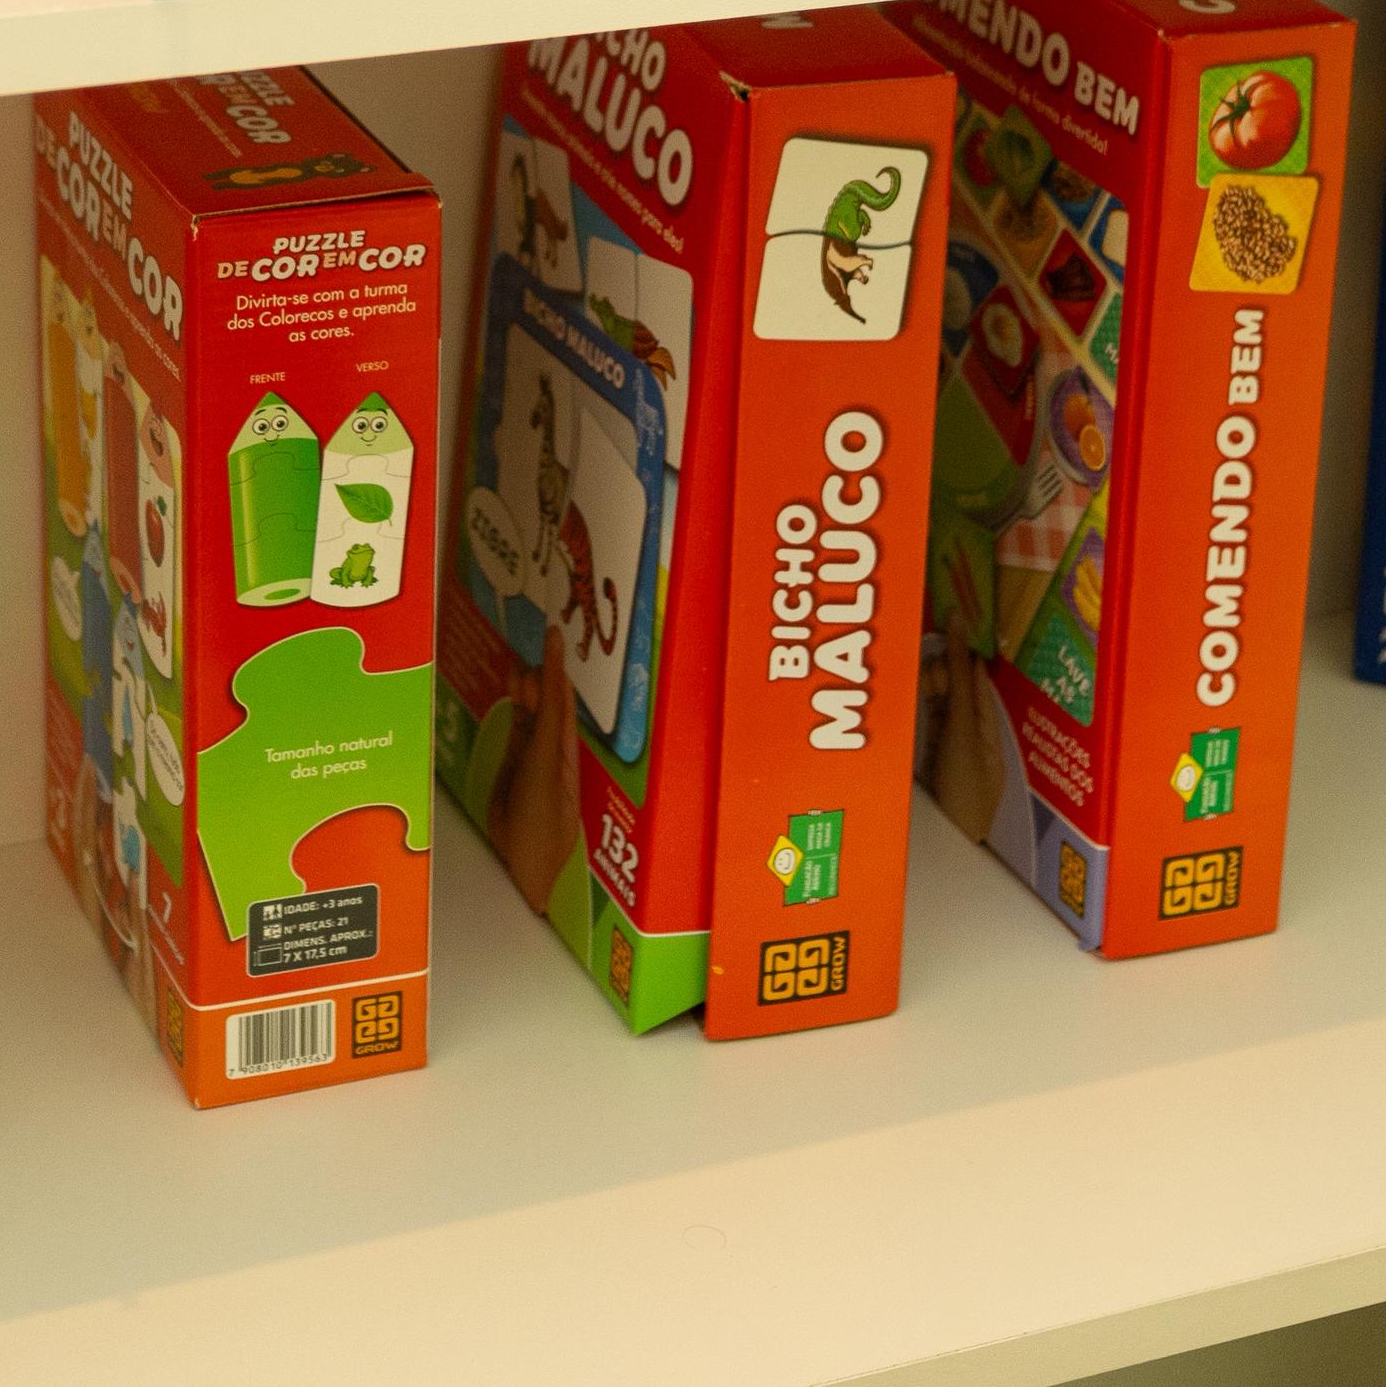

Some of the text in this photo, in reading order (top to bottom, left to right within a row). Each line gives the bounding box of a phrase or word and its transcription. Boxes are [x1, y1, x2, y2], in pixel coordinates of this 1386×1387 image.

[1073, 60, 1140, 136] BEM
[527, 37, 693, 206] MALUCO
[68, 111, 133, 221] PUZZLE
[56, 145, 100, 242] COR
[127, 237, 183, 342] COR
[272, 230, 366, 255] PUZZLE
[217, 244, 426, 282] DE COR EM COR
[227, 297, 416, 330] dos Colorecos e aprenda
[236, 284, 408, 311] Divirta-se com a turma
[288, 326, 355, 343] as cores.
[249, 372, 286, 384] FRENTE
[356, 360, 389, 372] VERSO
[1197, 415, 1257, 707] COMENDO
[1227, 308, 1267, 406] BEM
[768, 504, 817, 682] BICHO
[809, 411, 884, 750] MALUCO
[265, 730, 393, 763] Tamanho natural
[291, 759, 367, 779] das peças
[601, 814, 639, 884] 132
[284, 896, 363, 915] IDADE: +3 anos
[299, 917, 349, 932] PEÇAS: 21
[283, 936, 328, 951] DIMENS.
[284, 946, 348, 964] 7 X 17,5 cm
[830, 936, 845, 991] GROW
[355, 1041, 400, 1055] GROW
